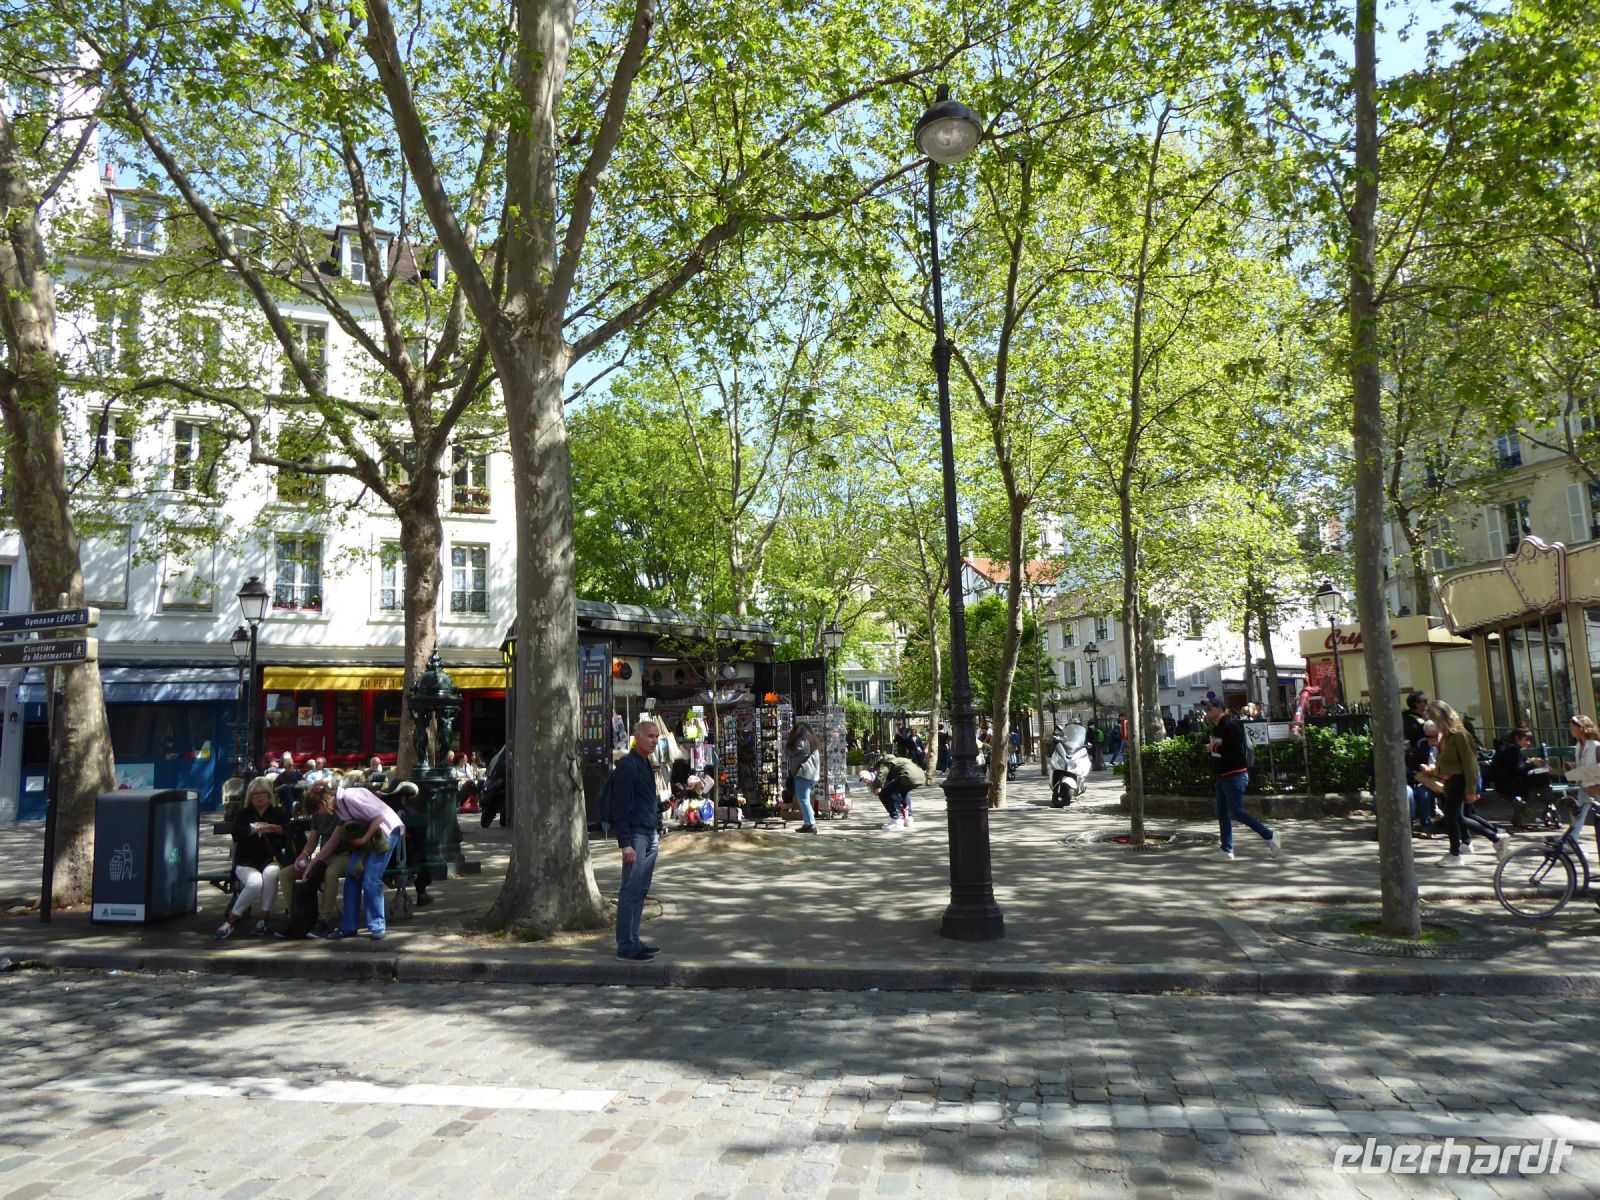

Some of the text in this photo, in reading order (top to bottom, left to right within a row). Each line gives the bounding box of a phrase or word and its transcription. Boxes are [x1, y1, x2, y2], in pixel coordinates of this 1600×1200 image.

[25, 613, 76, 626] Gymnase LEPIC
[32, 652, 72, 661] Montmartre
